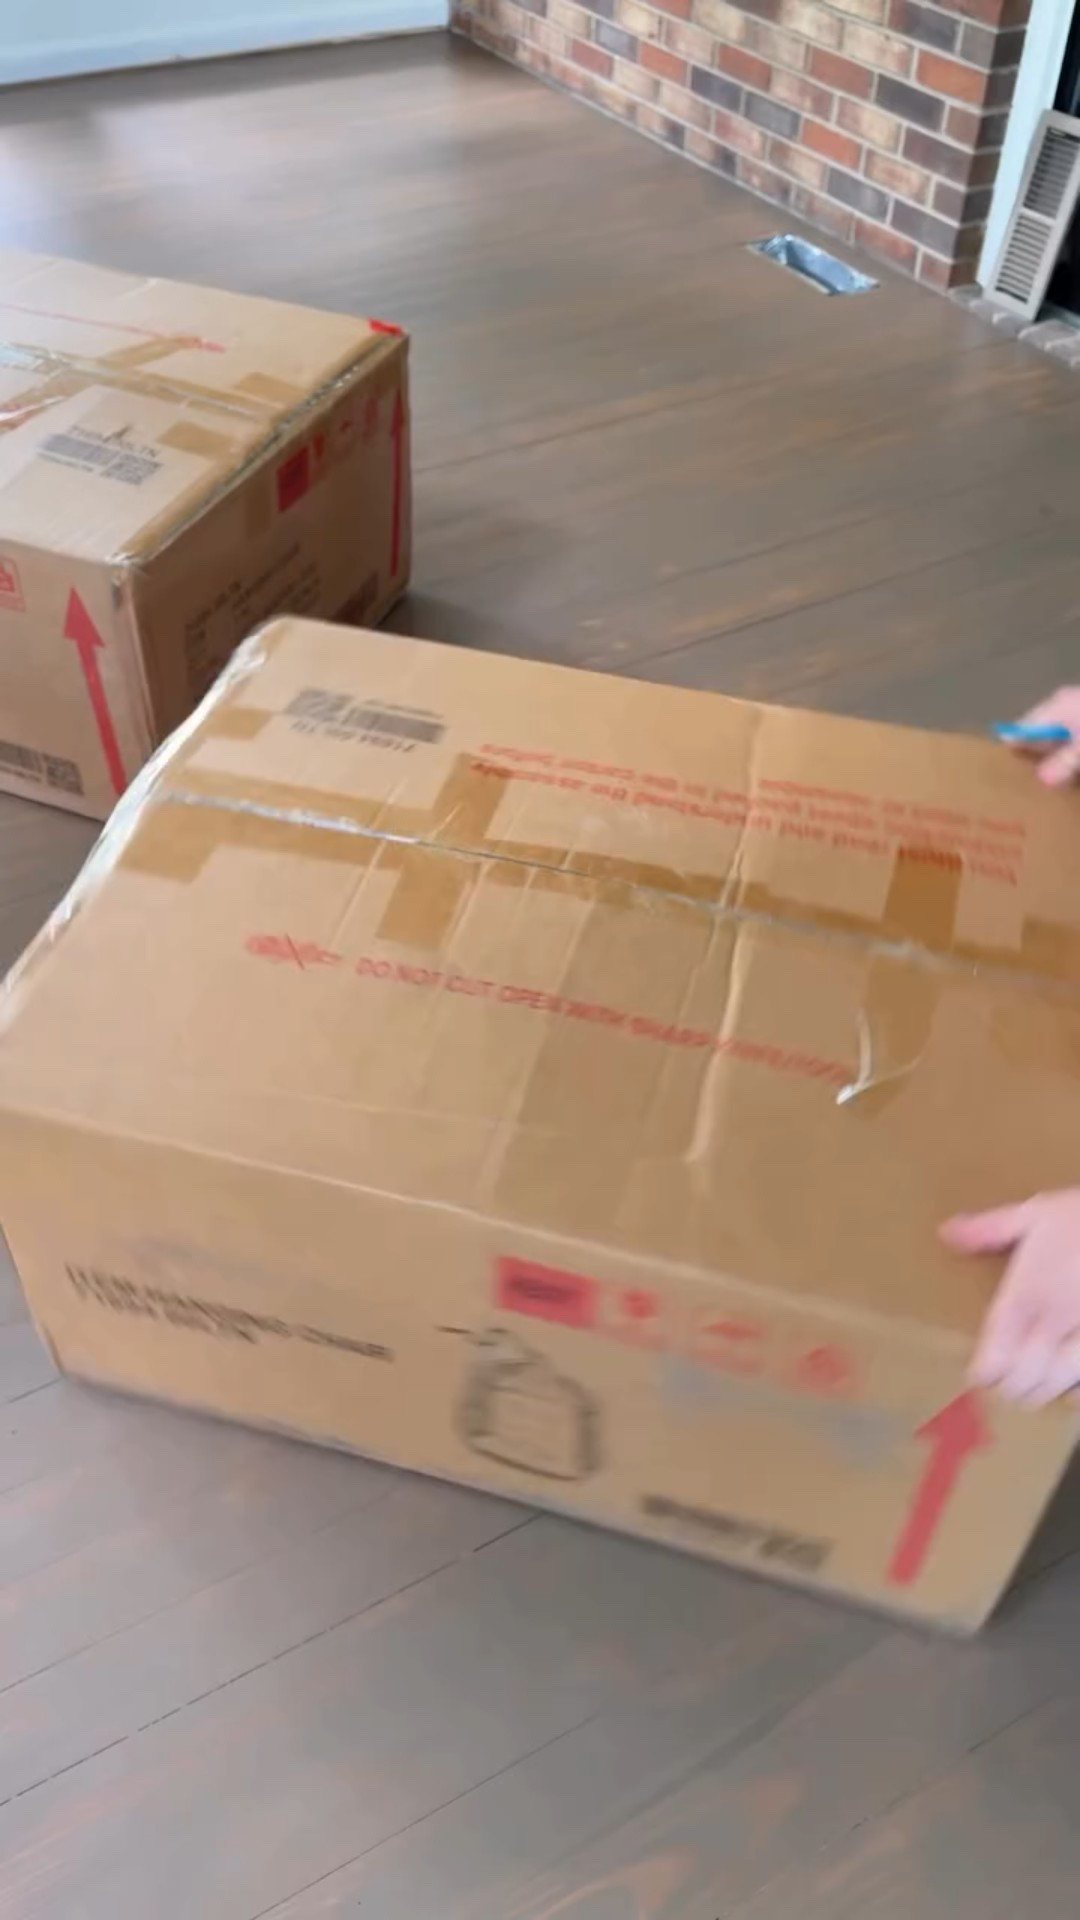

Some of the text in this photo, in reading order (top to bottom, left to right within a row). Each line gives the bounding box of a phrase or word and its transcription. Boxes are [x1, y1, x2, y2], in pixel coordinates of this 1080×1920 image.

[354, 957, 393, 978] DO
[395, 964, 445, 985] NOT
[446, 975, 496, 996] CUT
